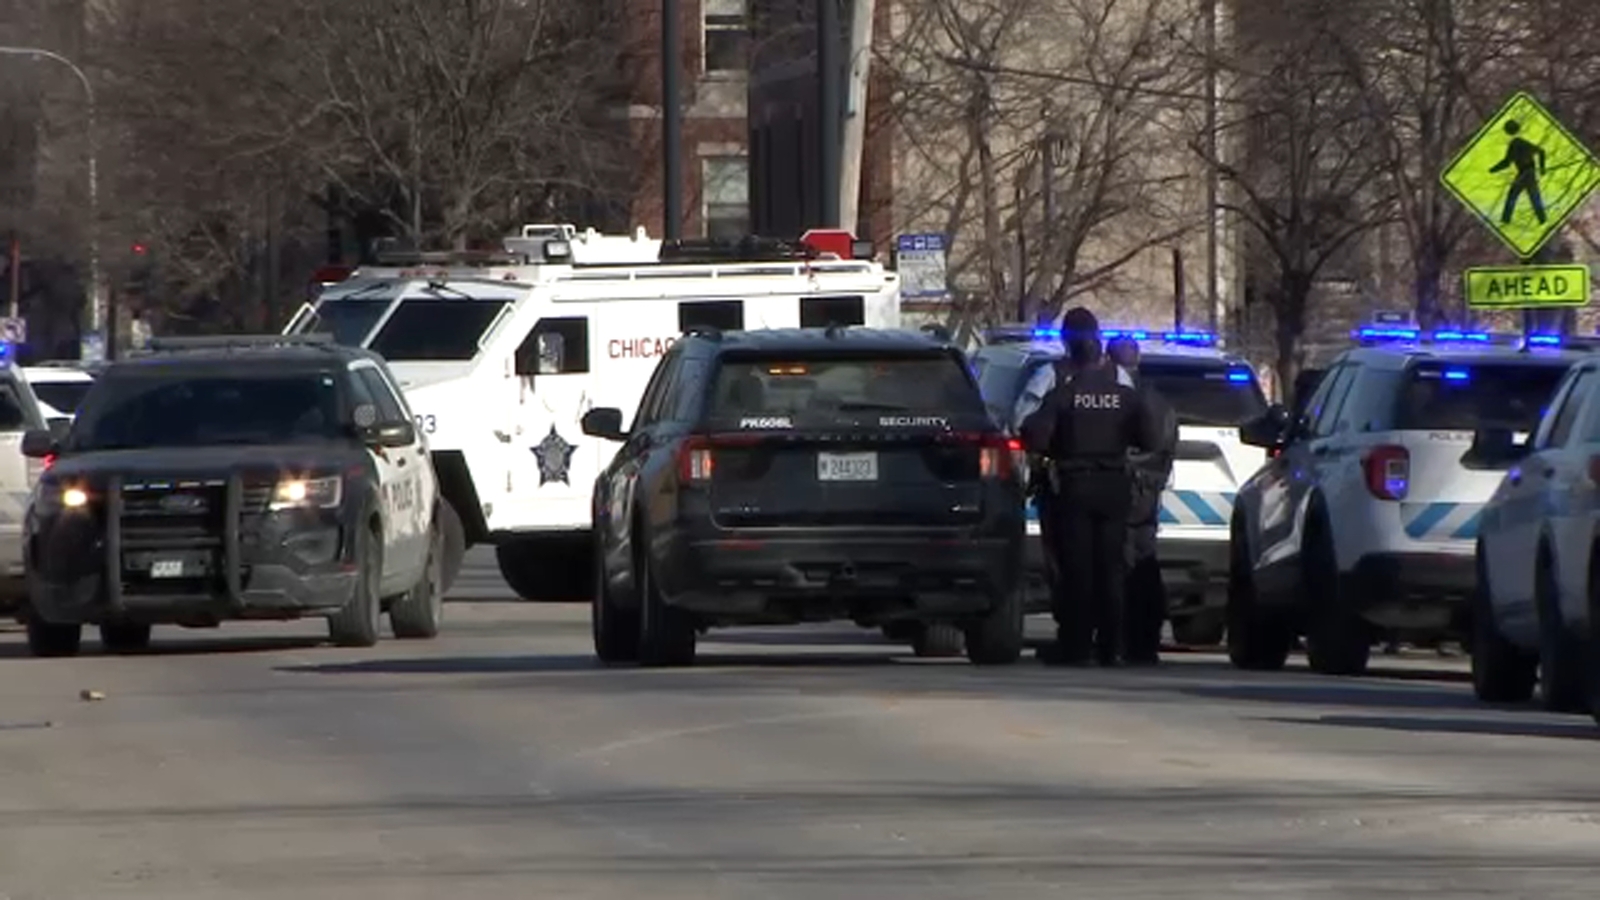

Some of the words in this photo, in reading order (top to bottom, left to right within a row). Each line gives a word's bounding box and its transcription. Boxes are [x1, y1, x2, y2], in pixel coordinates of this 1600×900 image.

[1486, 276, 1569, 299] AHEAD
[1074, 394, 1120, 408] POLICE
[879, 416, 949, 426] SECURITY
